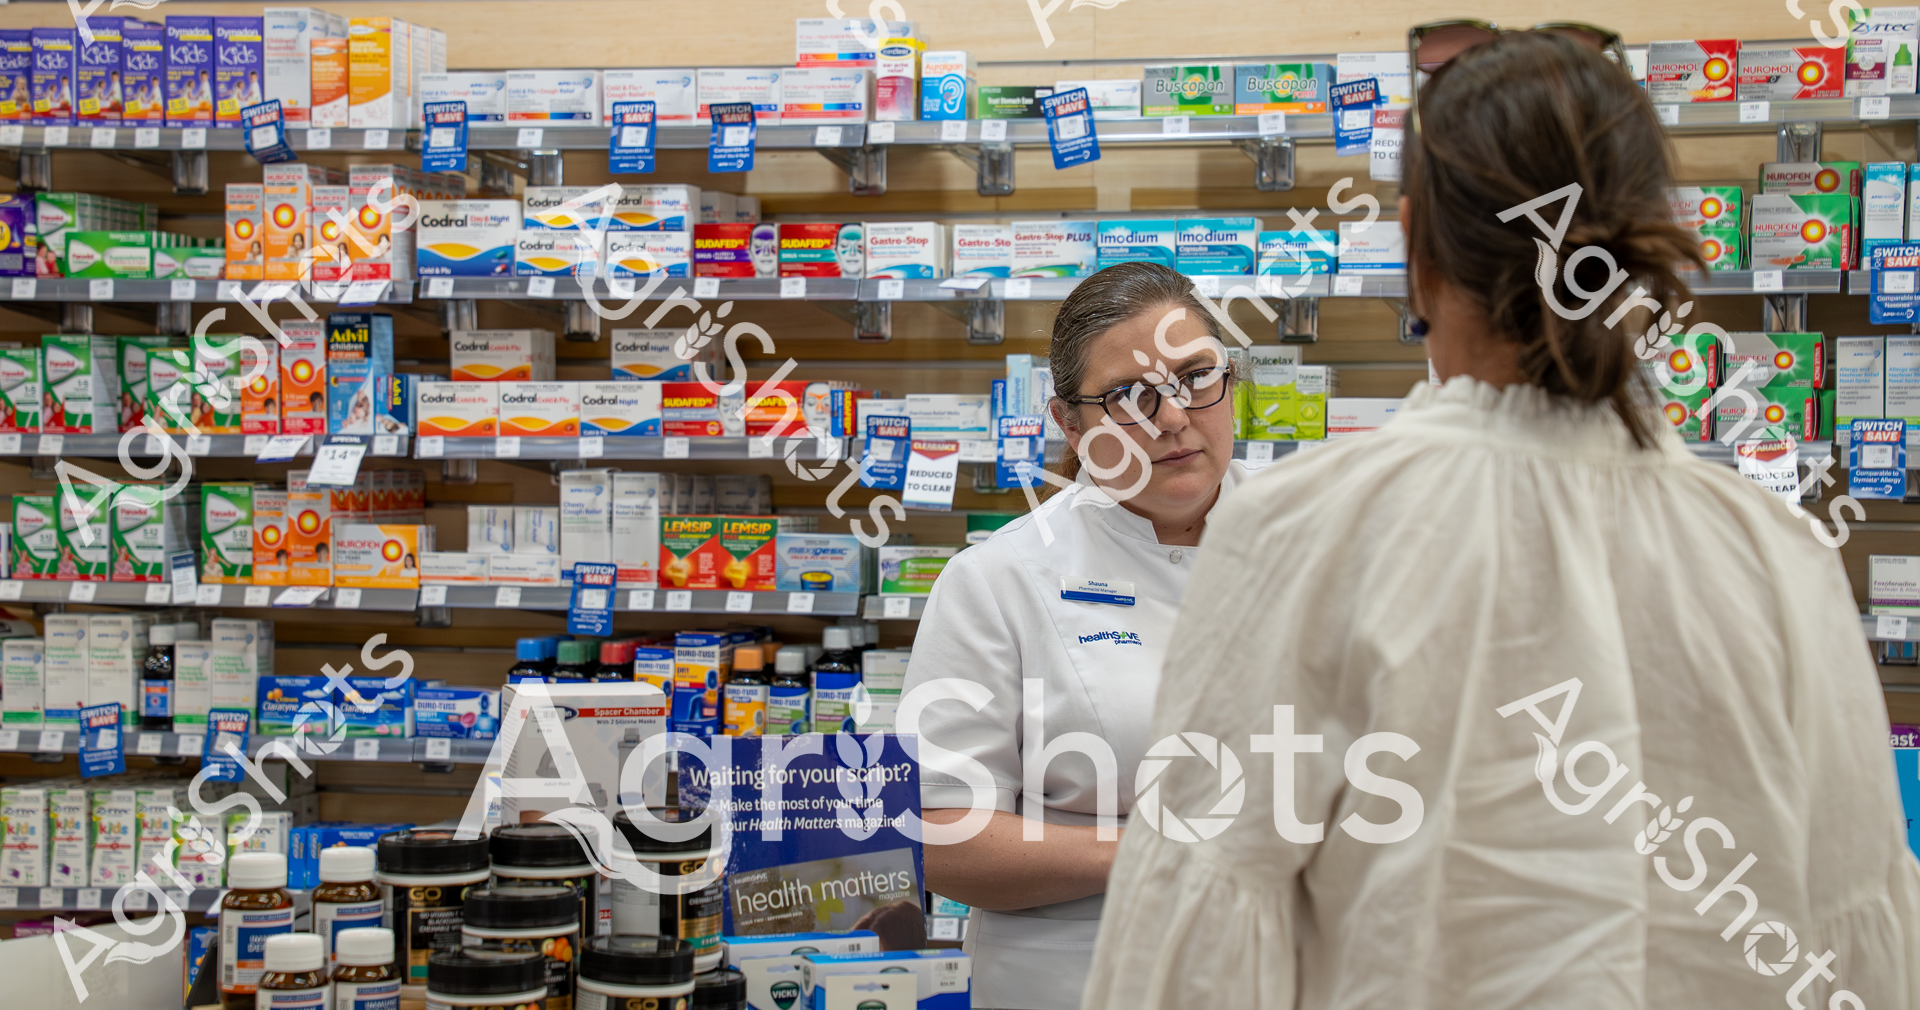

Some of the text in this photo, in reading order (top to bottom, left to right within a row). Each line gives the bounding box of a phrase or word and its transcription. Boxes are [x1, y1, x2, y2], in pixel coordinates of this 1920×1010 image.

[1851, 22, 1913, 35] Zyrtec
[79, 29, 120, 44] Dymadon
[168, 29, 210, 45] Dymadon
[217, 29, 259, 45] Dymadon
[33, 39, 70, 54] Dymadon
[123, 41, 160, 55] Dymadon
[81, 47, 119, 65] Kids
[170, 46, 208, 65] Kids
[219, 46, 257, 65] Kids
[37, 55, 69, 71] Kids
[127, 55, 158, 71] Kids
[925, 63, 964, 73] Auralgan
[1652, 62, 1699, 73] NUROMOL
[1743, 65, 1794, 75] NUROMOL
[1156, 78, 1225, 96] Buscopan
[1247, 75, 1317, 95] Buscopan
[1331, 81, 1375, 97] SWITCH
[1044, 89, 1086, 109] SWITCH
[1294, 91, 1317, 99] FORTE
[1344, 91, 1372, 104] SAVE
[425, 103, 465, 114] SWITCH
[614, 103, 654, 114] SWITCH
[1057, 101, 1085, 115] SAVE
[436, 113, 464, 123] SAVE
[625, 113, 652, 123] SAVE
[1373, 151, 1386, 159] TO
[1767, 172, 1811, 181] NUROFEN
[527, 197, 562, 208] Codral
[420, 214, 467, 228] Codral
[1755, 223, 1798, 232] NUROFEN
[871, 236, 928, 249] Gastro-Stop
[1067, 233, 1091, 242] PLUS
[1101, 232, 1158, 243] Imodium
[1178, 231, 1237, 243] Imodium
[519, 241, 554, 251] Codral
[610, 243, 646, 253] Codral
[695, 240, 738, 249] SUDAFED
[781, 240, 824, 249] SUDAFED
[1261, 240, 1308, 252] Imodium
[1100, 246, 1129, 255] Capsules
[1874, 247, 1920, 258] SWITCH
[1886, 257, 1919, 267] SAVE
[1877, 295, 1913, 303] Comparable
[330, 328, 369, 343] Advil
[330, 343, 364, 352] children
[455, 341, 489, 352] Codral
[615, 342, 669, 354] Codral Night
[49, 361, 75, 369] Panadol
[1251, 355, 1294, 366] Dulcolax
[1857, 377, 1871, 385] Spray
[393, 376, 402, 406] Advil
[421, 393, 455, 404] Codral
[502, 393, 537, 404] Codral
[582, 395, 618, 406] Codral
[663, 398, 706, 408] SUDAFED
[747, 397, 790, 407] SUDAFED
[868, 417, 910, 427] SWITCH
[1000, 417, 1042, 427] SWITCH
[1853, 422, 1903, 431] SWITCH
[879, 427, 906, 436] SAVE
[1012, 426, 1039, 435] SAVE
[1866, 432, 1899, 441] SAVE
[912, 442, 956, 452] CLEARANCE
[1741, 443, 1791, 454] CLEARANCE
[910, 470, 953, 480] REDUCED
[1744, 471, 1795, 480] REDUCED
[1880, 477, 1902, 485] Allergy
[908, 483, 951, 493] TO CLEAR
[563, 501, 585, 510] Chesty
[121, 509, 148, 517] Panadol
[210, 510, 237, 518] Panadol
[563, 508, 584, 517] Cough
[665, 521, 712, 534] LEMSIP
[723, 521, 771, 534] LEMSIP
[337, 541, 380, 550] NUROFEN
[1874, 580, 1917, 588] Fexofenadine
[1114, 639, 1142, 647] pharmacy
[677, 649, 717, 660] DURO-TUSS
[637, 662, 671, 671] DURO-TUSS
[727, 688, 759, 696] DURO-TUSS
[262, 700, 299, 713] Claratyne
[340, 702, 376, 714] Claratyne
[594, 707, 660, 718] Spacer Chamber
[616, 718, 638, 726] Silicone
[639, 718, 657, 726] Masks
[690, 762, 912, 791] Waiting for your script?
[720, 795, 883, 814] Make the most of your time
[55, 818, 81, 831] kids
[99, 822, 128, 835] kids
[141, 818, 169, 831] kids
[721, 815, 906, 832] our Health Matters magazine!
[6, 823, 36, 836] kids
[679, 861, 707, 873] GO
[410, 887, 442, 900] GO
[736, 869, 911, 916] health matters
[879, 891, 911, 903] magazine
[768, 914, 791, 922] SEPTEMBER
[772, 990, 798, 1000] VICKS
[626, 997, 659, 1010] GO
